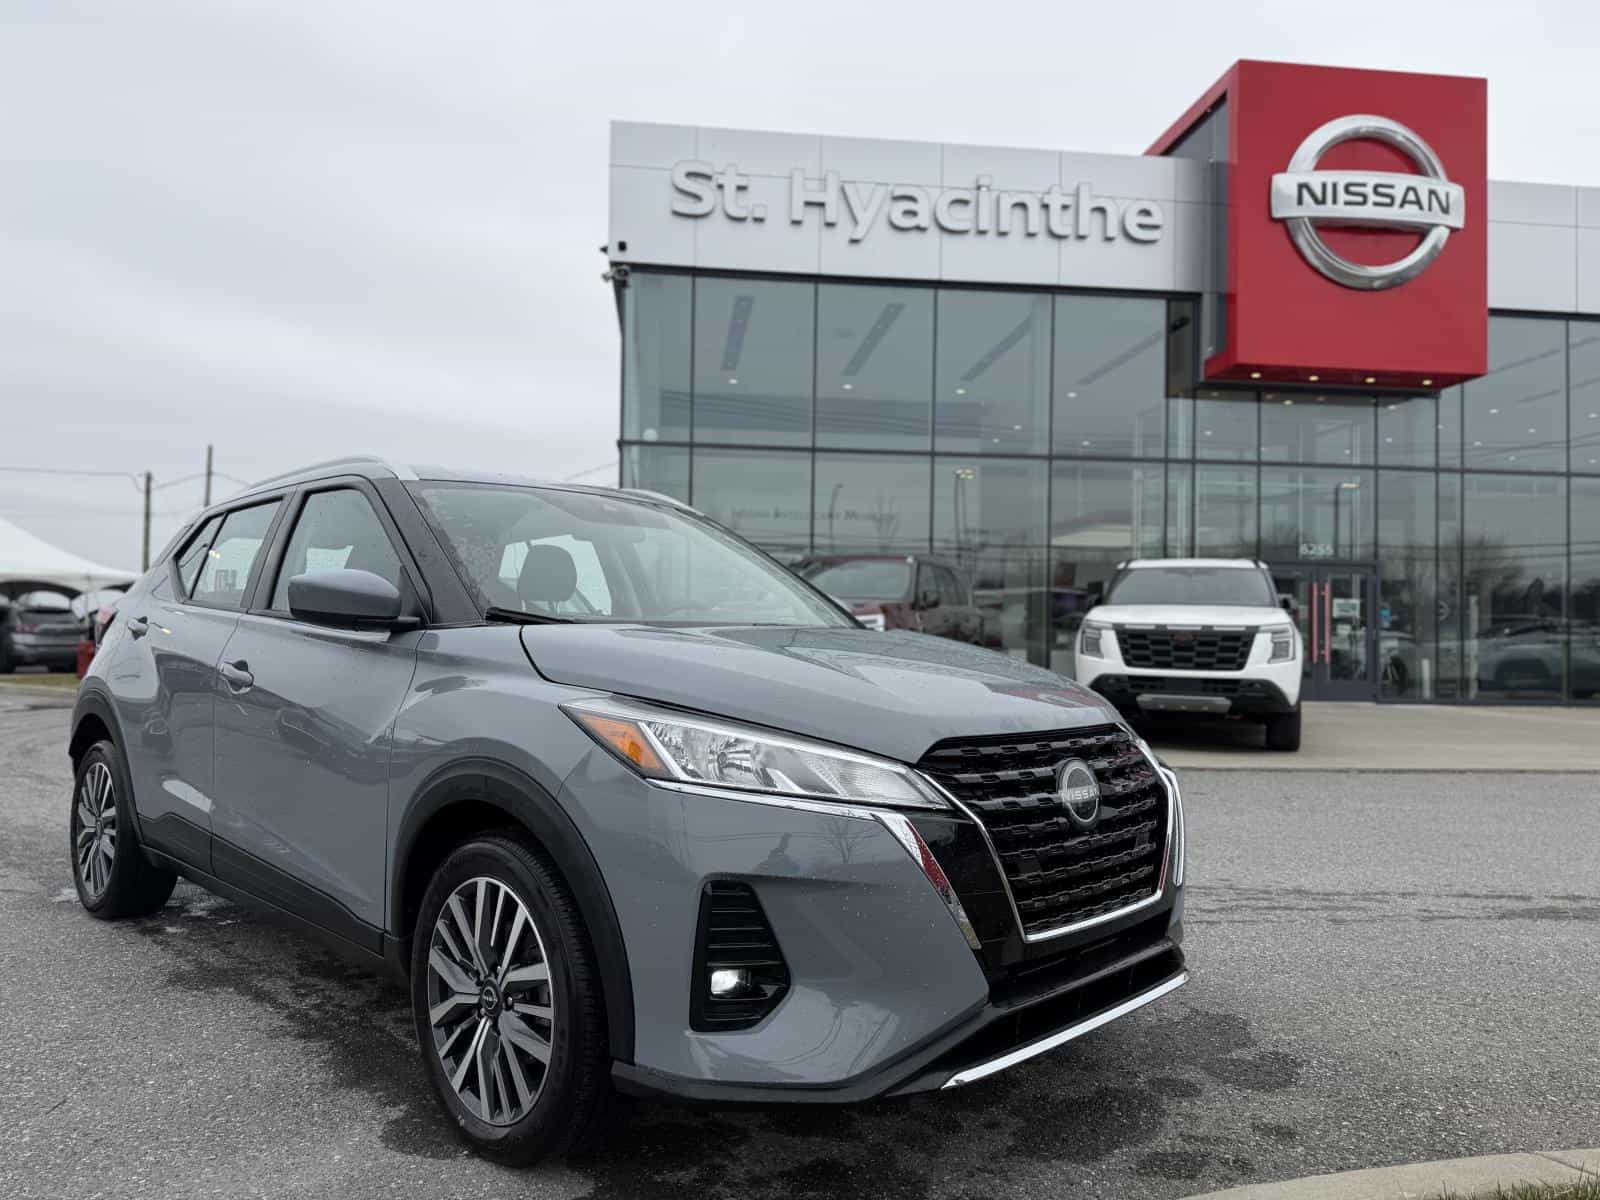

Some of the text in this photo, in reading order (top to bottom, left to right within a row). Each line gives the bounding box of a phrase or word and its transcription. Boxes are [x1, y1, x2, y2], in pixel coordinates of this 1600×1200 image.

[671, 160, 1163, 245] St. Hyacinthe
[1296, 181, 1451, 215] NISSAN
[1061, 787, 1099, 802] NISSAN
